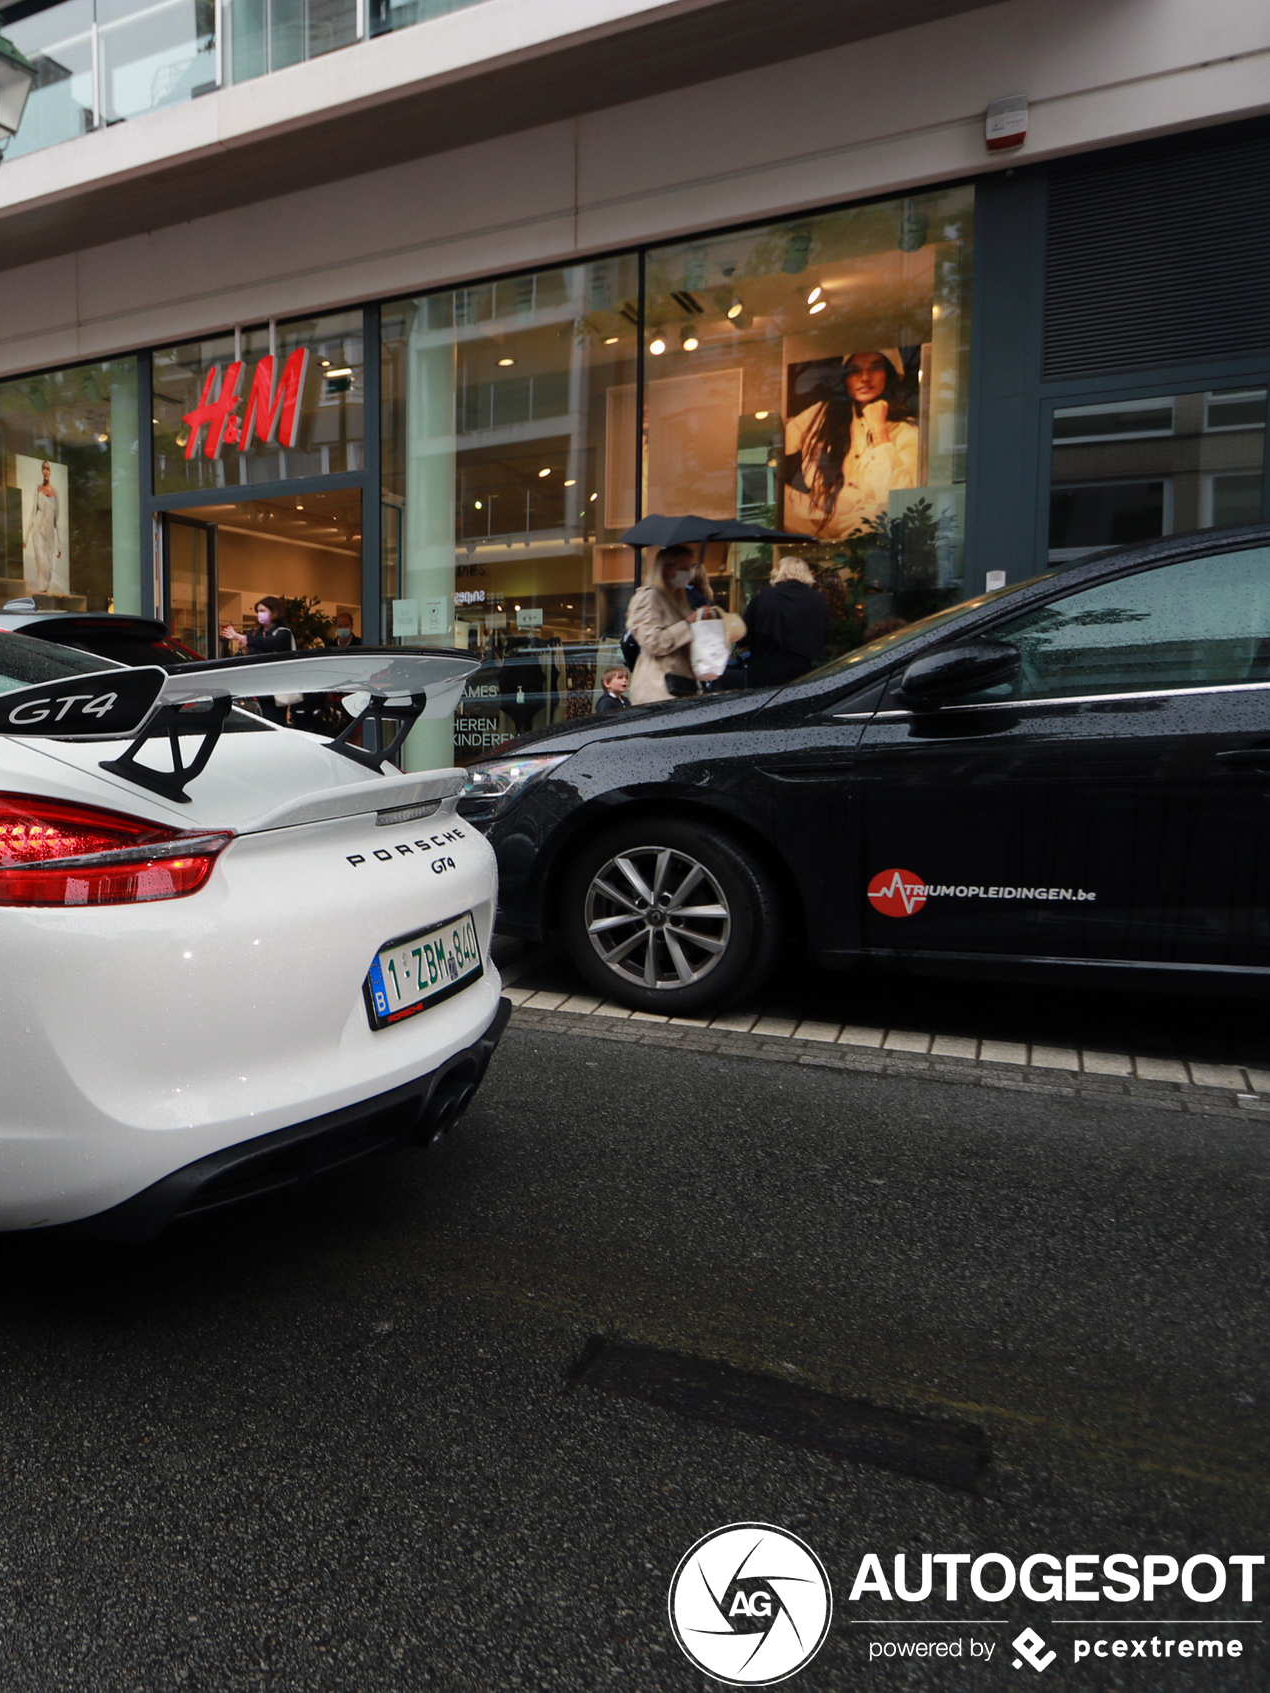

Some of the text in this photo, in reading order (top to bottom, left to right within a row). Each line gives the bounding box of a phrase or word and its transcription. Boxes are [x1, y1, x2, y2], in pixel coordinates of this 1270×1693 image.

[182, 346, 309, 460] H&M
[8, 691, 118, 725] GT4
[453, 718, 497, 731] HEREN
[346, 828, 466, 868] PORSCHE
[431, 857, 456, 875] GT4
[375, 991, 387, 1013] B
